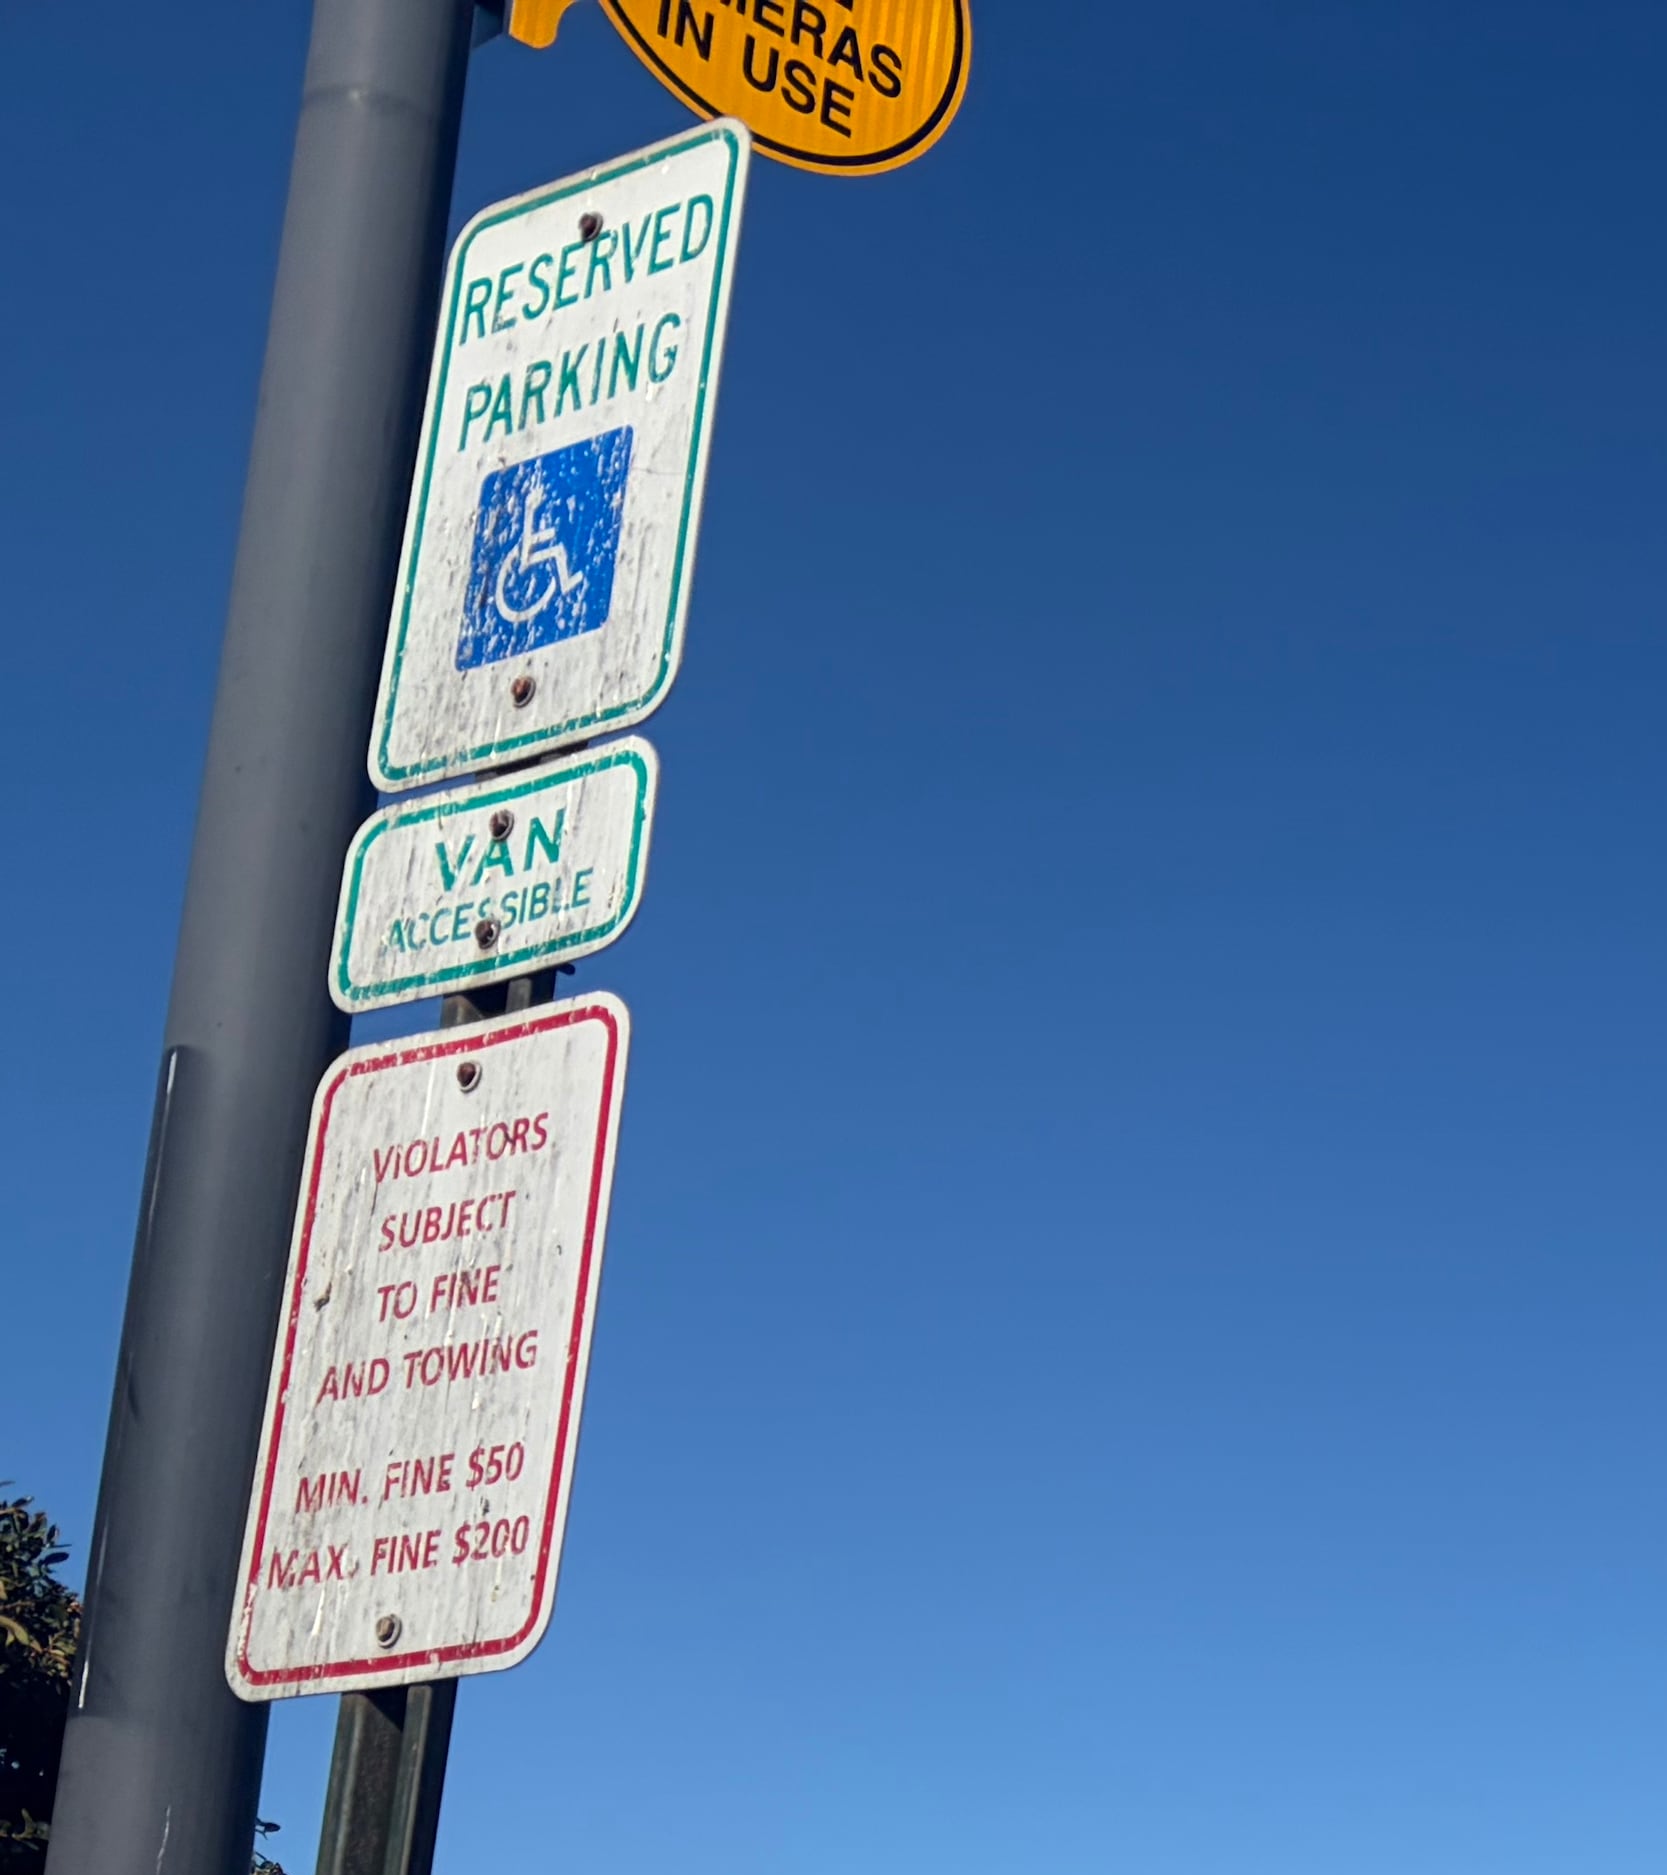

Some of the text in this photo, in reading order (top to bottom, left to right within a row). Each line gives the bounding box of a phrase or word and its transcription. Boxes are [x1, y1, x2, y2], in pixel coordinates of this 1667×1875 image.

[657, 0, 855, 139] IN USE
[459, 193, 714, 345] RESERVED
[458, 313, 683, 451] PARKING
[434, 808, 567, 892] VAN
[374, 1111, 550, 1184] VIOLATORS
[377, 1191, 517, 1252] SUBJECT
[377, 1265, 501, 1323] TO FINE
[316, 1330, 539, 1405] AND TOWING
[294, 1440, 526, 1514] MIN. FINE $50
[267, 1515, 530, 1590] MAX. FINE $200
